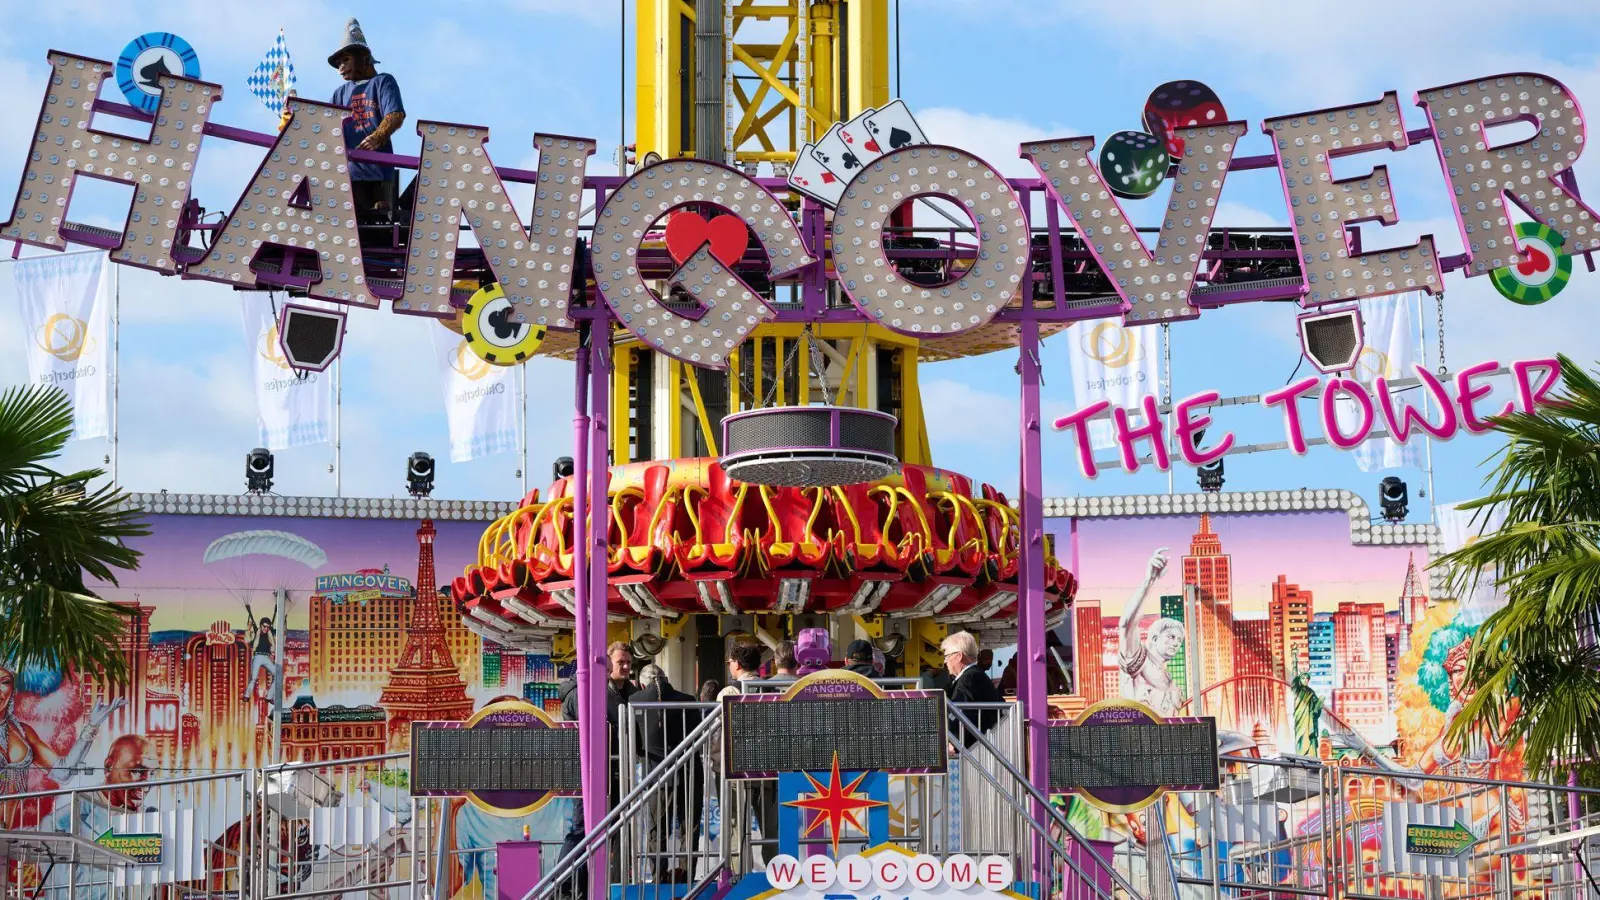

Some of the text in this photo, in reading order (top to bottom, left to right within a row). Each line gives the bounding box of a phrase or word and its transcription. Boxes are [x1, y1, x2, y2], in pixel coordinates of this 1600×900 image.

[0, 50, 1600, 370] HANGOVER
[1052, 357, 1564, 480] THE TOWER
[317, 575, 408, 591] HANGOVER
[804, 684, 863, 693] HANGOVER
[149, 703, 177, 732] NO
[484, 714, 538, 723] HANGOVER
[1092, 711, 1144, 719] HANGOVER
[1408, 828, 1468, 841] ENTRANCE
[99, 838, 162, 847] ENTRANCE
[1415, 839, 1460, 848] EINGANG
[115, 847, 160, 856] INGANG
[772, 863, 1003, 883] WELCOME
